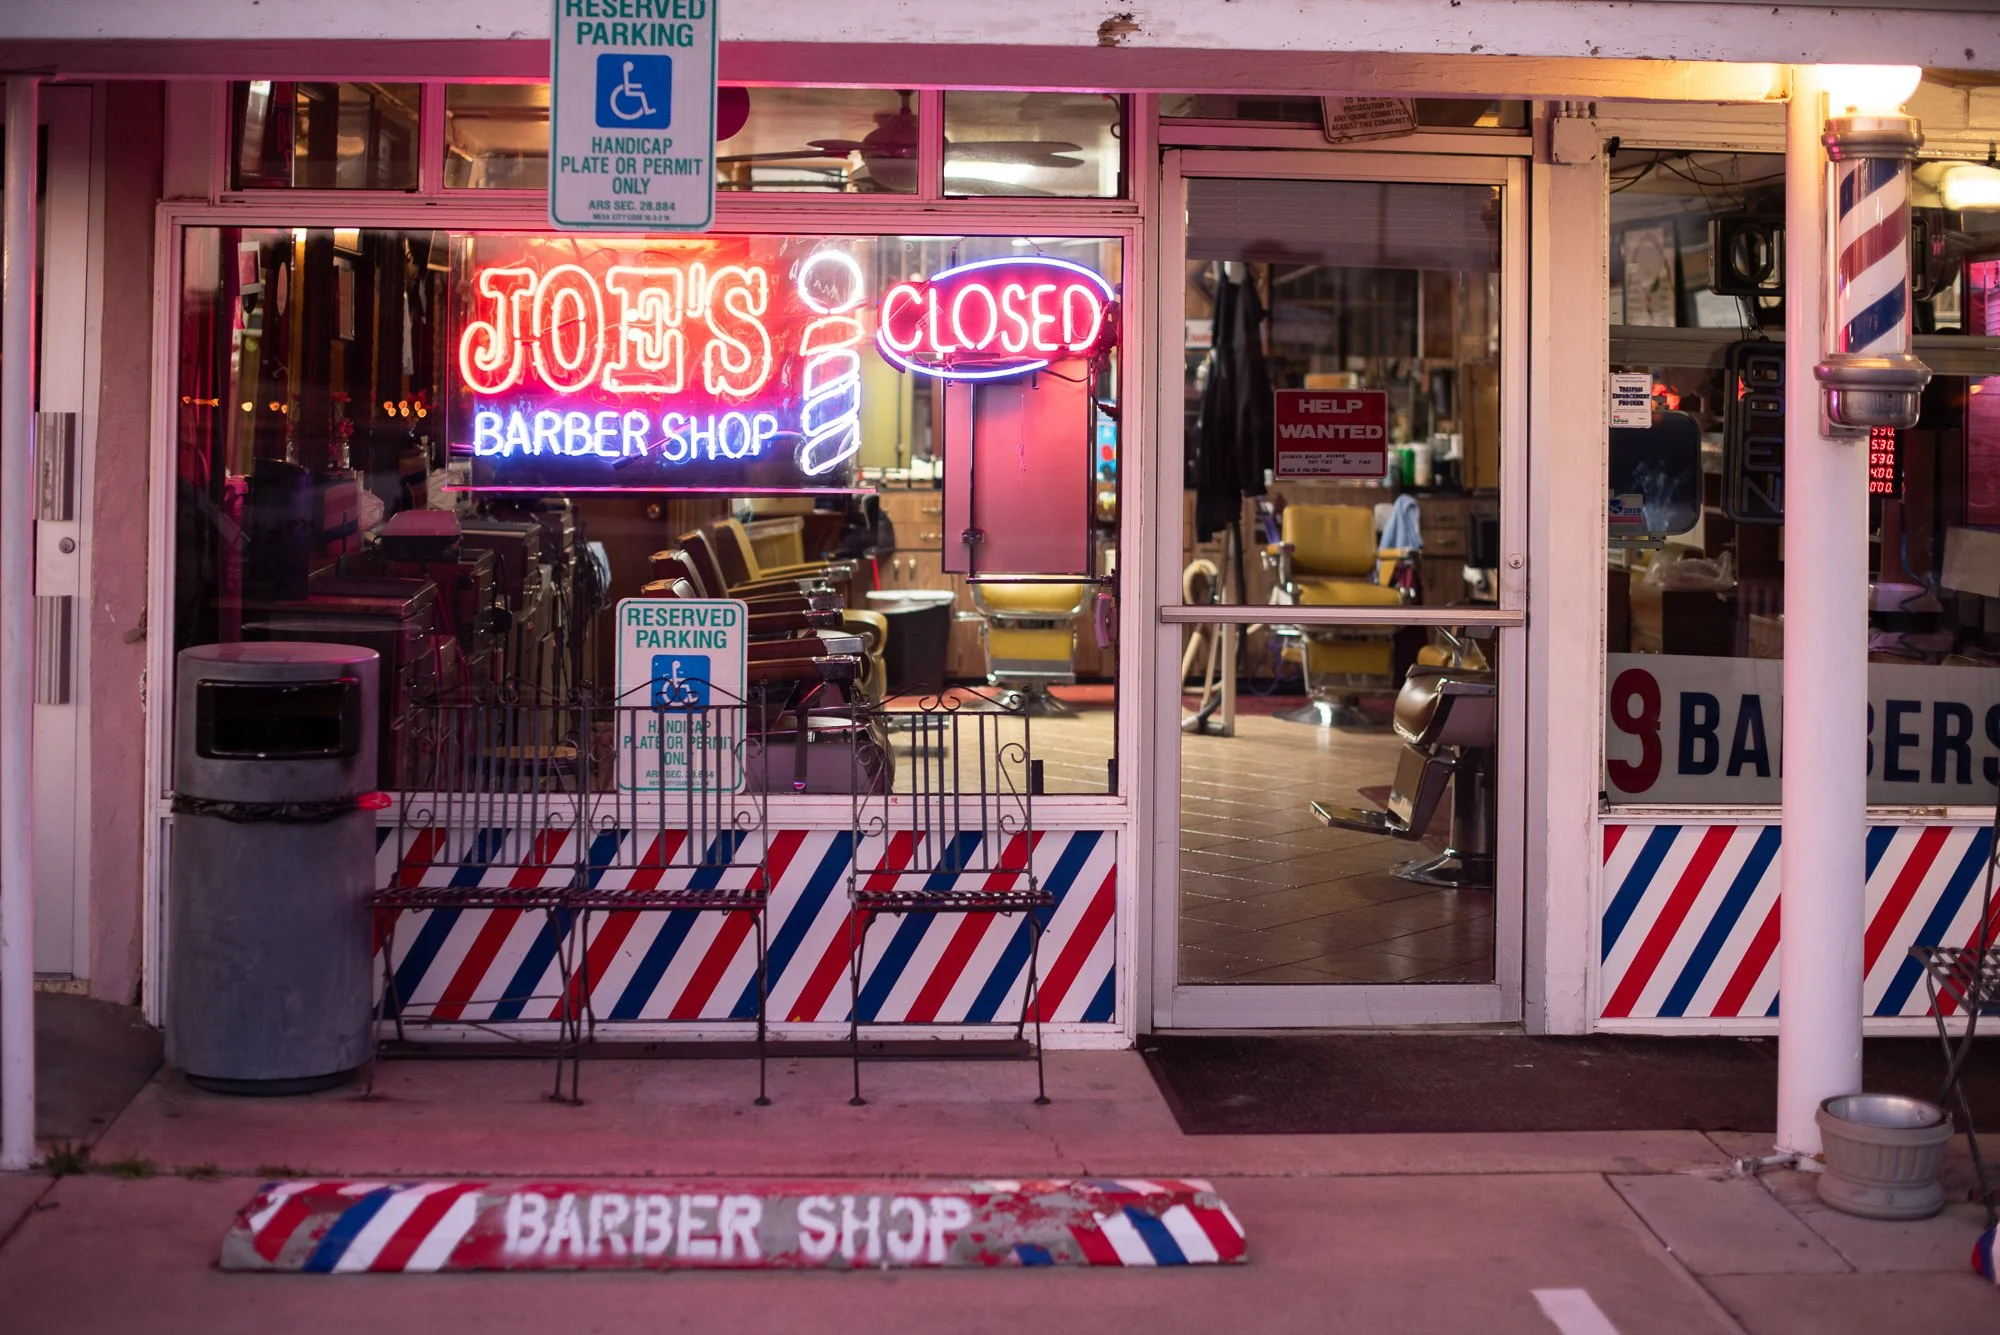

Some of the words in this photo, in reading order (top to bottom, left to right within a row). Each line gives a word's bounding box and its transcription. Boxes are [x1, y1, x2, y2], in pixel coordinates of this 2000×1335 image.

[565, 0, 706, 20] RESERVED
[576, 22, 694, 47] PARKING
[591, 136, 673, 155] HANDICAP
[560, 157, 609, 174] PLATE
[615, 158, 637, 175] OR
[643, 158, 703, 176] PERMIT
[612, 177, 650, 195] ONLY
[588, 200, 611, 210] ARS
[613, 201, 637, 211] SEC.
[640, 201, 676, 212] 28.884
[880, 282, 1103, 355] CLOSED
[459, 263, 772, 396] JOE'S
[1298, 399, 1364, 414] HELP
[473, 409, 649, 459] BARBER
[662, 410, 779, 462] SHOP
[1278, 424, 1384, 440] WANTED
[627, 607, 737, 627] RESERVED
[635, 629, 728, 649] PARKING
[1606, 667, 1663, 794] 9
[666, 736, 683, 749] OR
[664, 752, 692, 765] ONL
[665, 770, 685, 779] SEC.
[503, 1191, 762, 1261] BARBER
